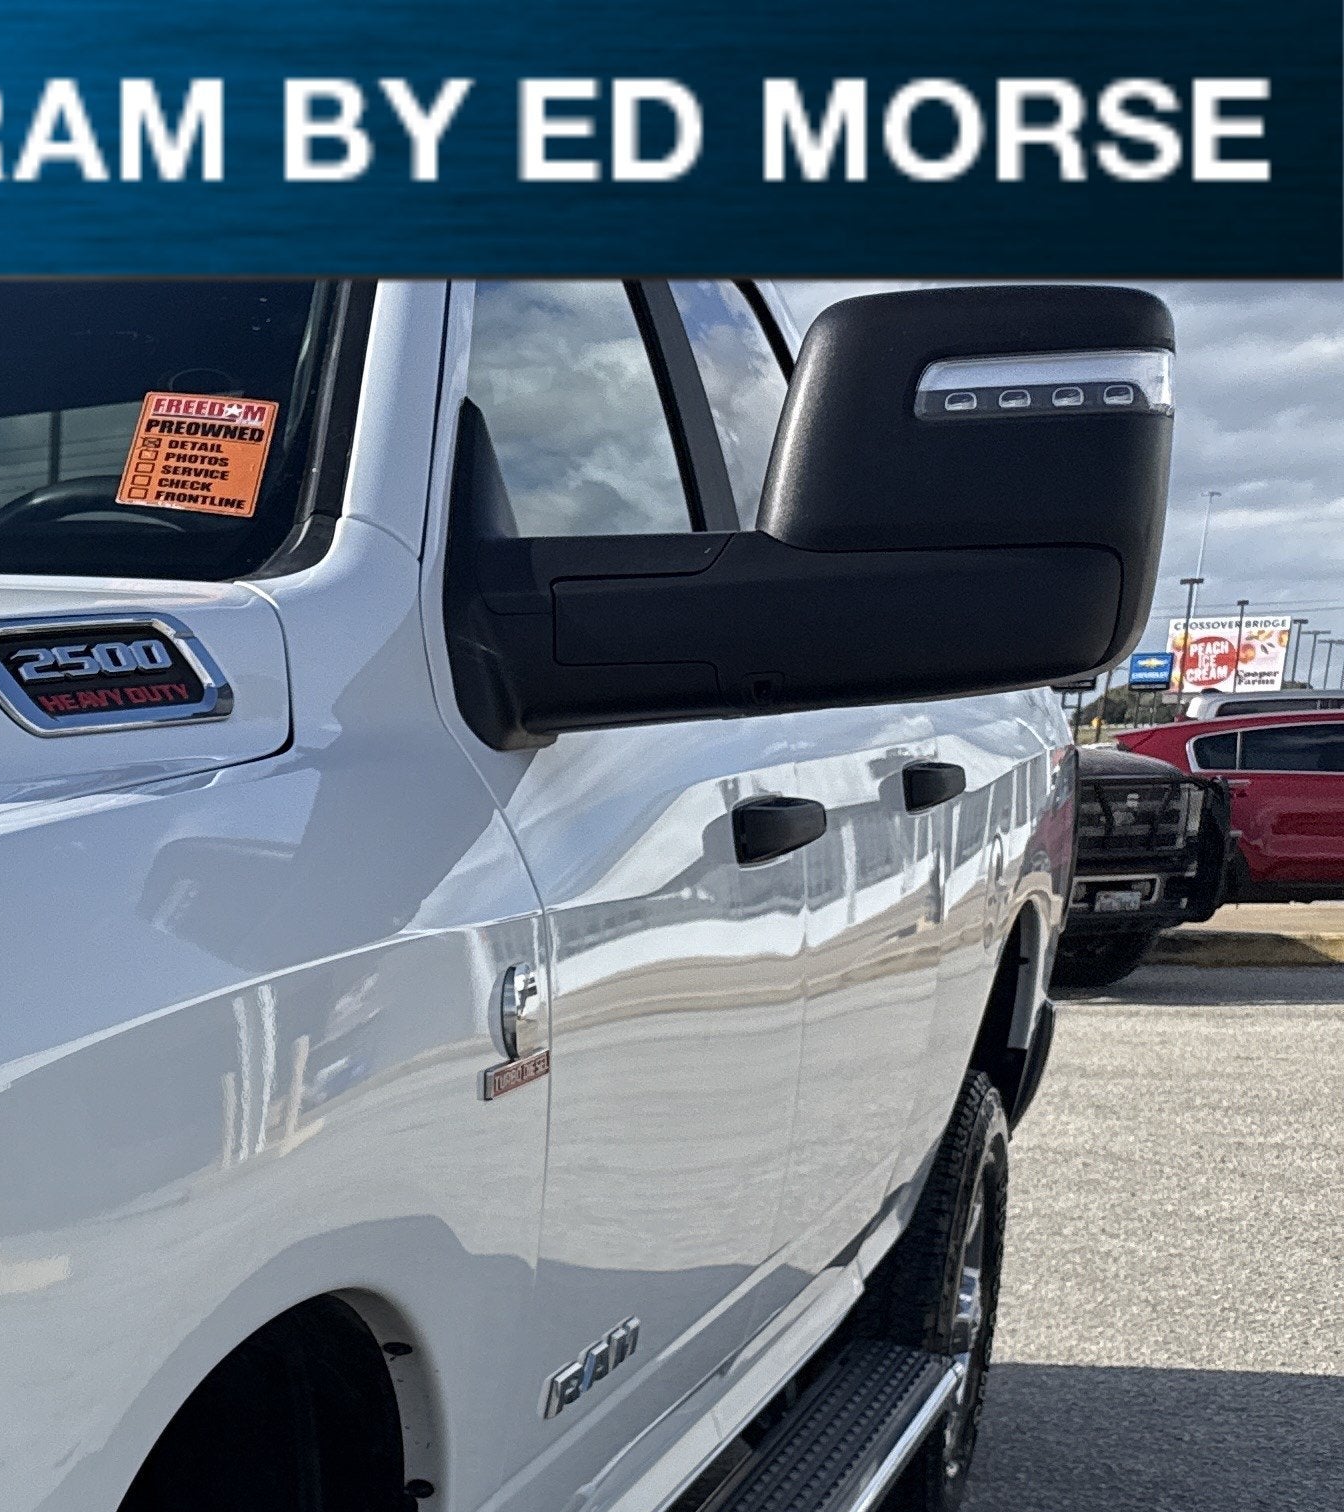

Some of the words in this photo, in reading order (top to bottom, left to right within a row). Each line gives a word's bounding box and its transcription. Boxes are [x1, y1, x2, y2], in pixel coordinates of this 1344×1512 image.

[153, 398, 265, 422] FREEDOM
[145, 419, 264, 442] PREOWNED
[167, 440, 224, 453] DETAIL
[164, 452, 229, 467] PHOTOS
[161, 465, 229, 481] SERVICE
[157, 477, 213, 492] CHECK
[154, 490, 246, 510] FRONTLINE
[1245, 619, 1287, 628] BRIDGE
[1189, 641, 1229, 656] PEACH
[12, 639, 173, 683] 2500
[1197, 654, 1217, 667] ICE
[1185, 665, 1229, 682] CREAM
[37, 686, 125, 713] HEAVY
[127, 683, 190, 704] DUTY
